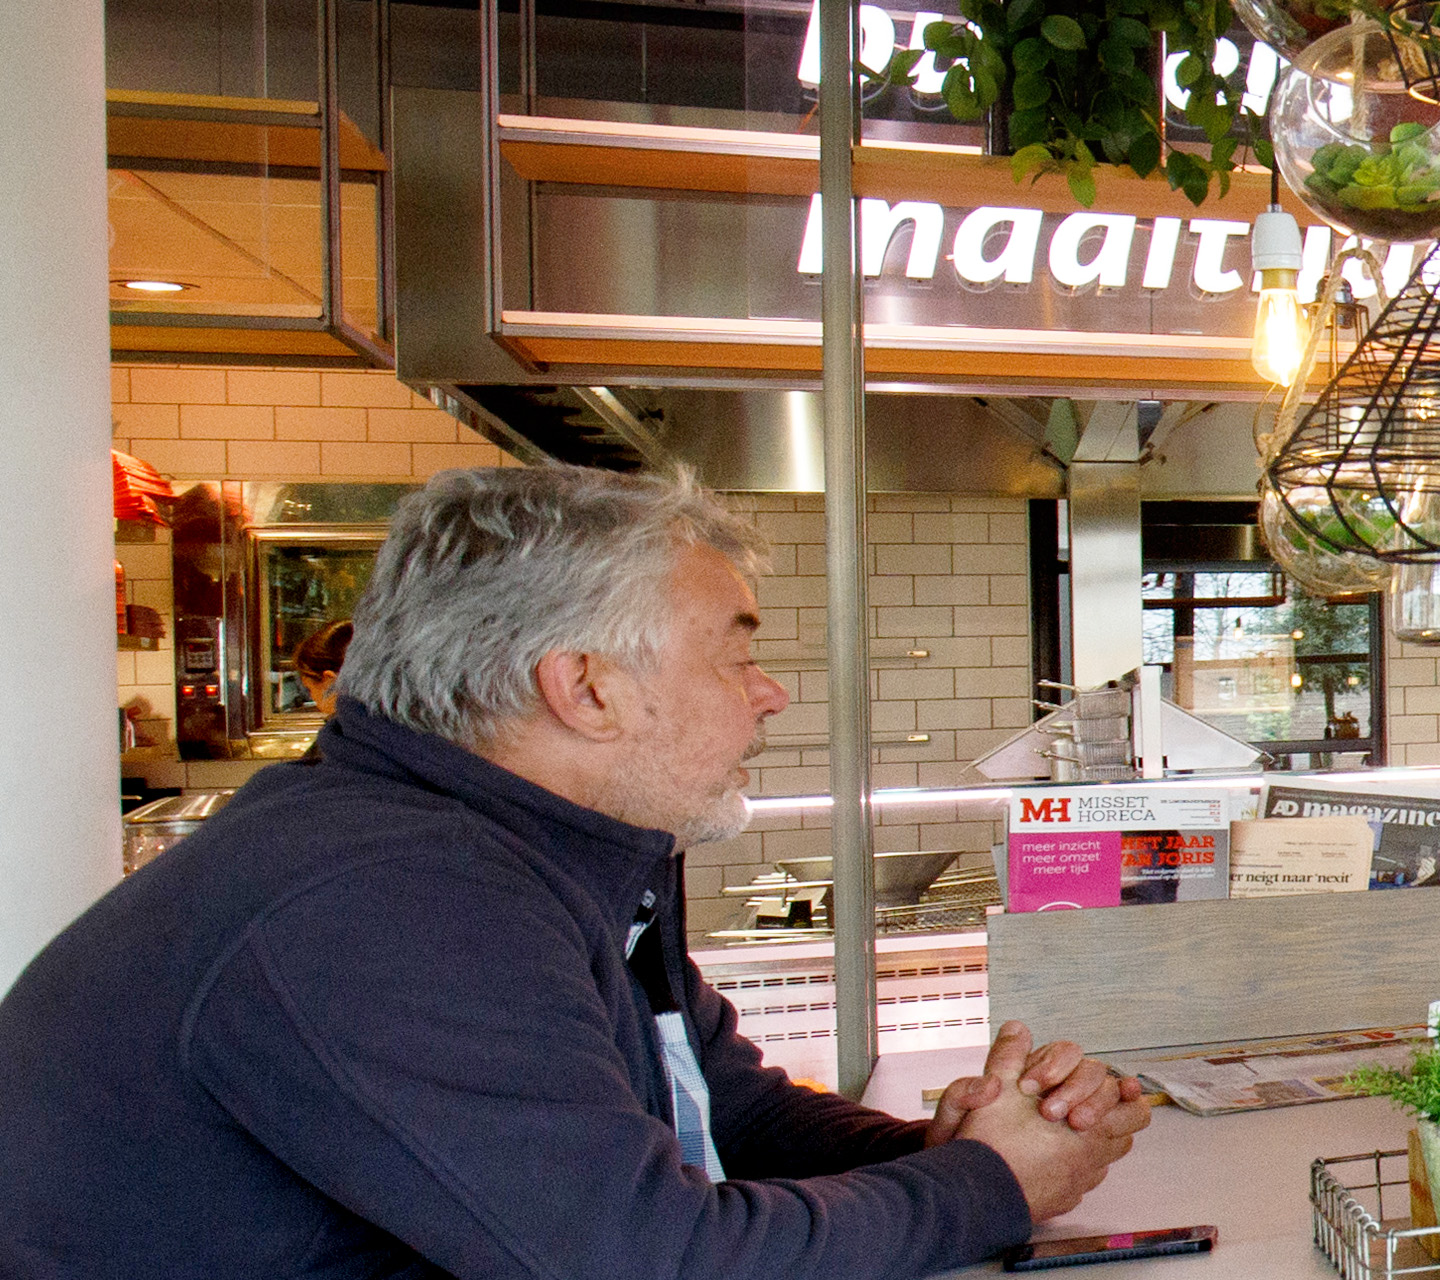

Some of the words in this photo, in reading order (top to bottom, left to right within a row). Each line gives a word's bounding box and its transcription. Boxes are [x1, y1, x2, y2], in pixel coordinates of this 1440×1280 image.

[1079, 797, 1148, 808] MISSET
[1079, 810, 1156, 822] HORECA
[1023, 843, 1055, 852] meer
[1059, 841, 1100, 851] inzicht
[1121, 838, 1161, 850] HET
[1167, 836, 1214, 848] JAAR
[1023, 854, 1056, 863] meer
[1060, 853, 1100, 862] omzet
[1158, 852, 1214, 866] JORIS
[1033, 866, 1067, 874] meer
[1071, 864, 1089, 874] tijd
[1246, 872, 1279, 884] neigt
[1282, 872, 1311, 883] naar
